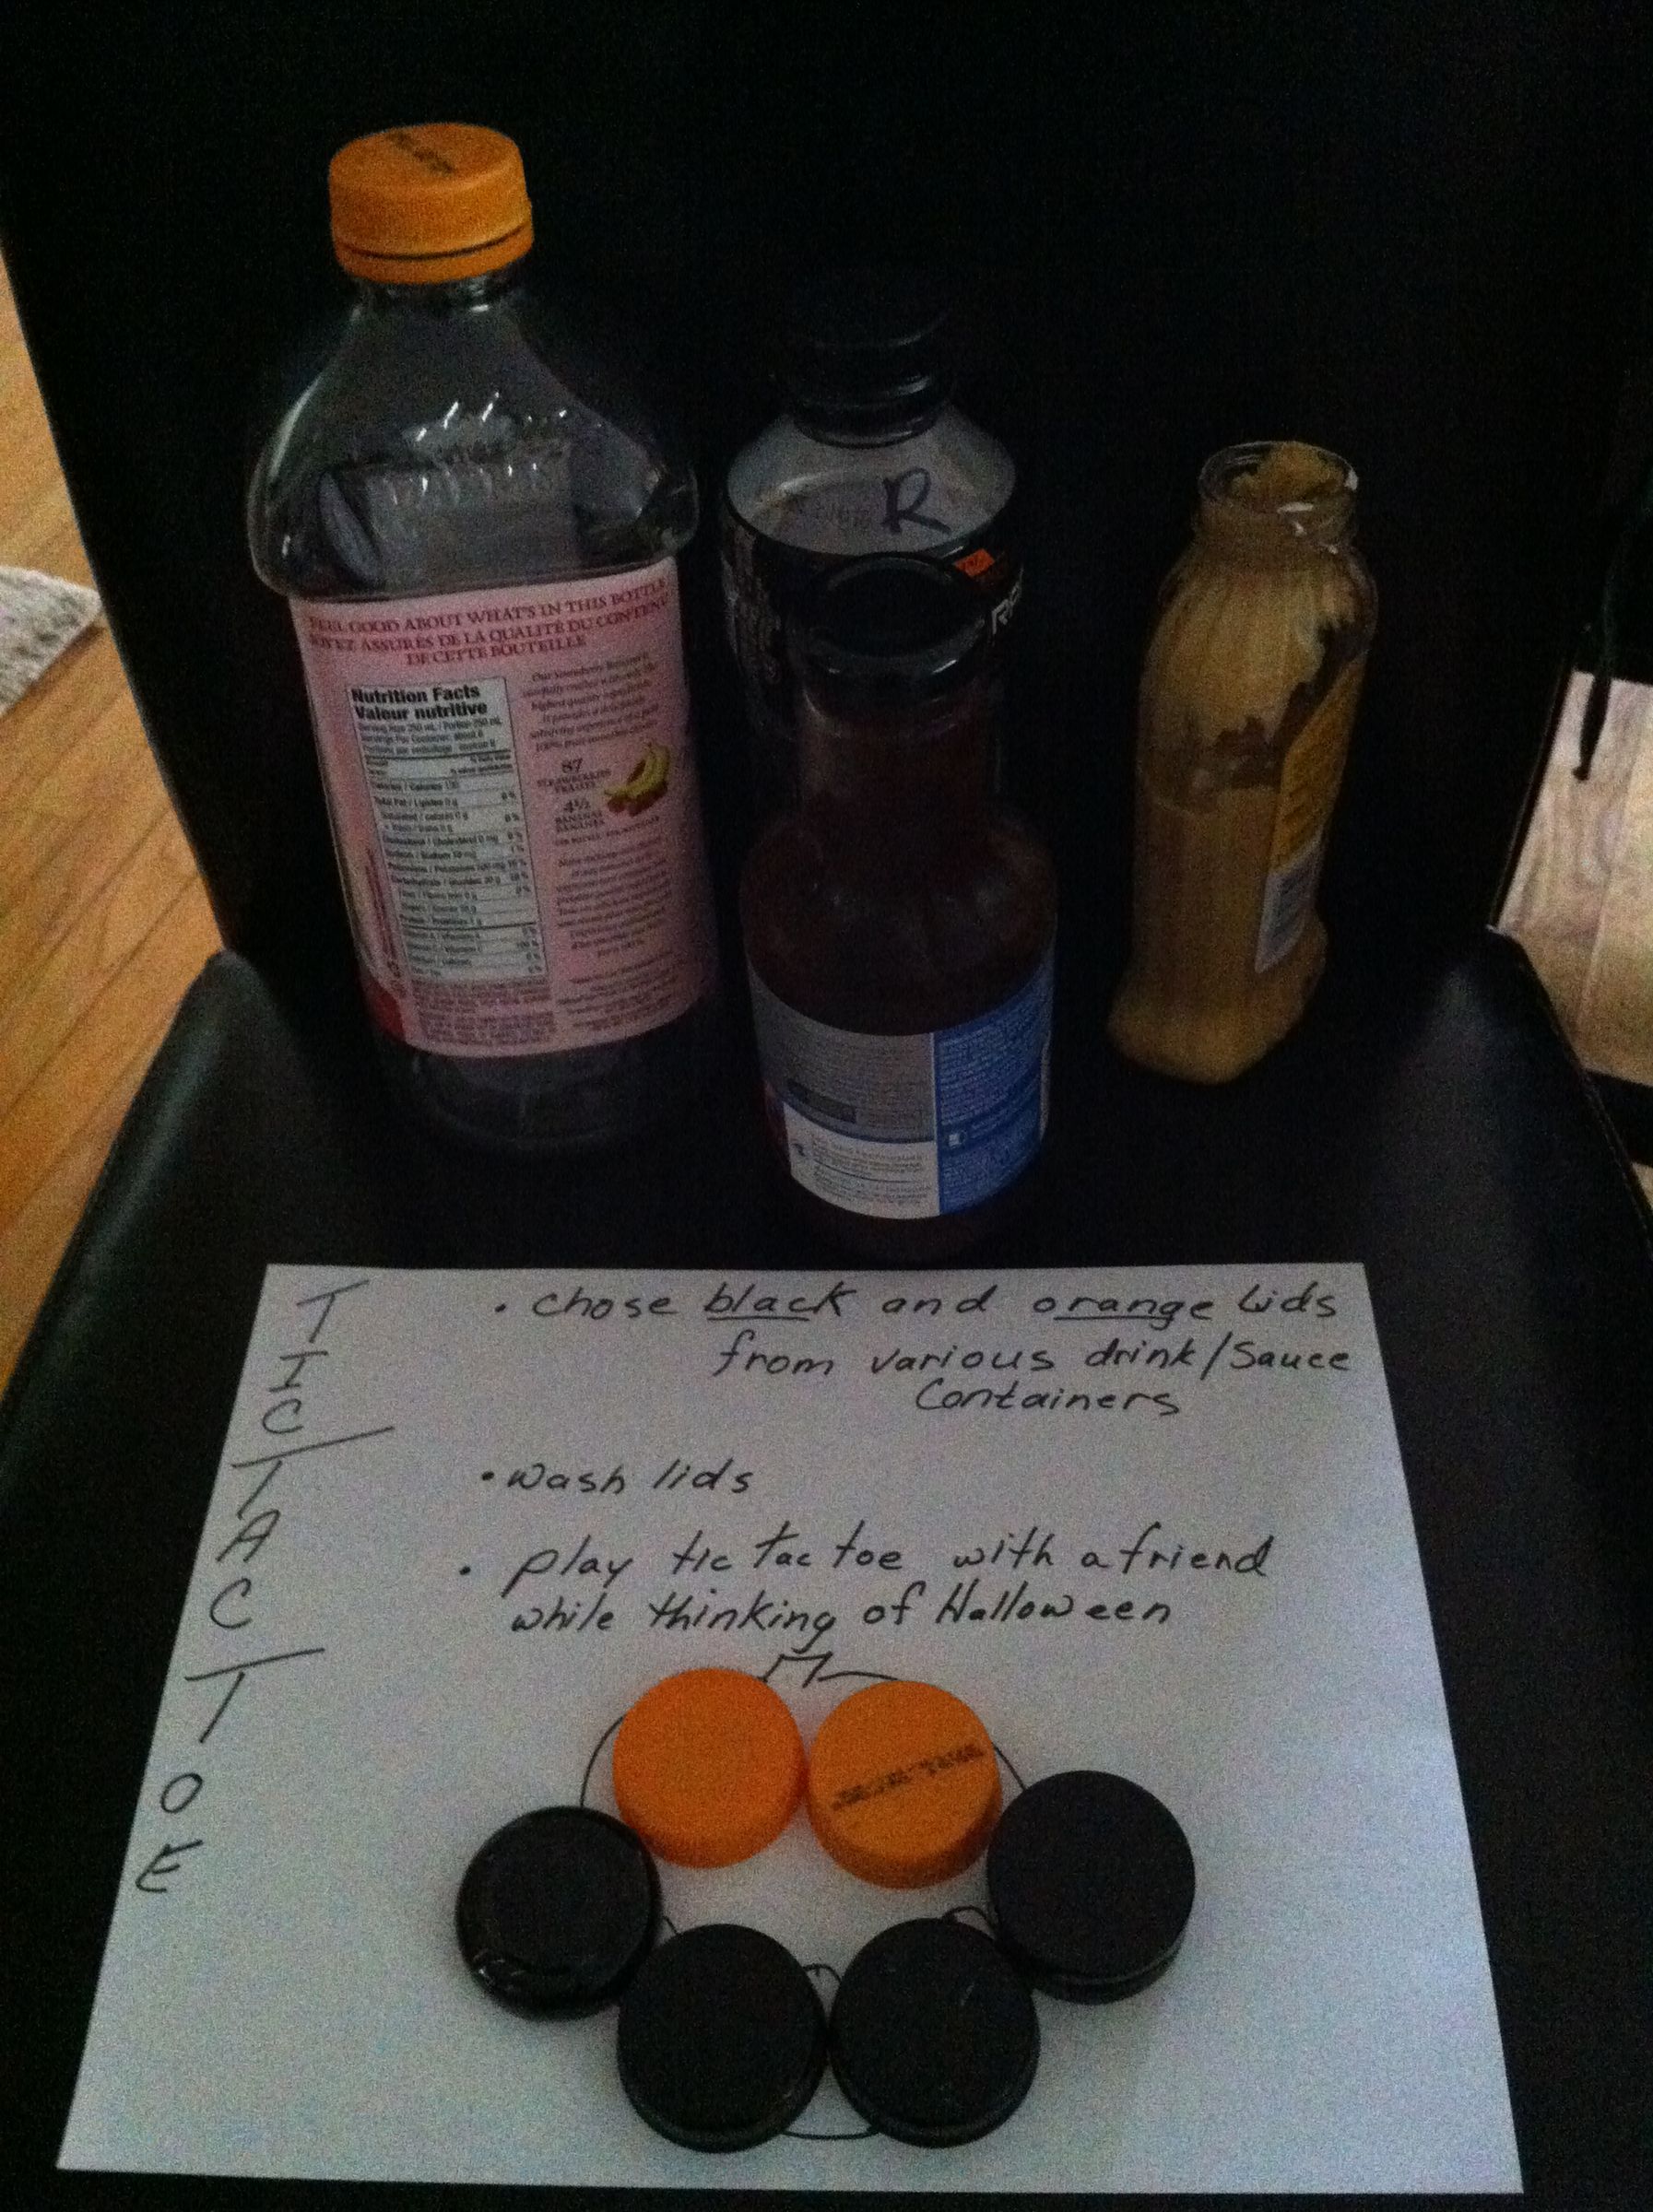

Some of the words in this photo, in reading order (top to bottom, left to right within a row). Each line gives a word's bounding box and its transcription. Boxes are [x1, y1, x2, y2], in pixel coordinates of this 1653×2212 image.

[882, 467, 952, 534] R
[348, 618, 400, 633] GOOD
[404, 614, 462, 630] ABOUT
[466, 605, 537, 624] WHAT'S
[539, 603, 562, 617] IN
[565, 595, 608, 614] THIS
[437, 633, 460, 647] DE
[463, 629, 486, 644] LA
[568, 618, 595, 633] DU
[407, 653, 430, 666] DE
[433, 646, 488, 664] CETTE
[490, 635, 586, 658] BOUTEILLE
[351, 688, 428, 704] Nutrition
[432, 684, 481, 701] Facts
[355, 706, 409, 721] Valeur
[415, 701, 488, 720] nutritive
[532, 1286, 679, 1320] chose
[703, 1280, 857, 1318] black
[882, 1284, 998, 1316] and
[1033, 1296, 1214, 1330] orange
[713, 1328, 834, 1377] from
[871, 1346, 1055, 1375] various
[653, 1457, 754, 1495] lids
[501, 1534, 634, 1597] play
[672, 1529, 734, 1575] tic
[753, 1520, 811, 1570] tac
[832, 1520, 903, 1569] toe
[953, 1525, 1055, 1568] with
[512, 1592, 615, 1633] while
[648, 1588, 836, 1655] thinking
[863, 1580, 927, 1626] of
[935, 1577, 1172, 1626] Halloween
